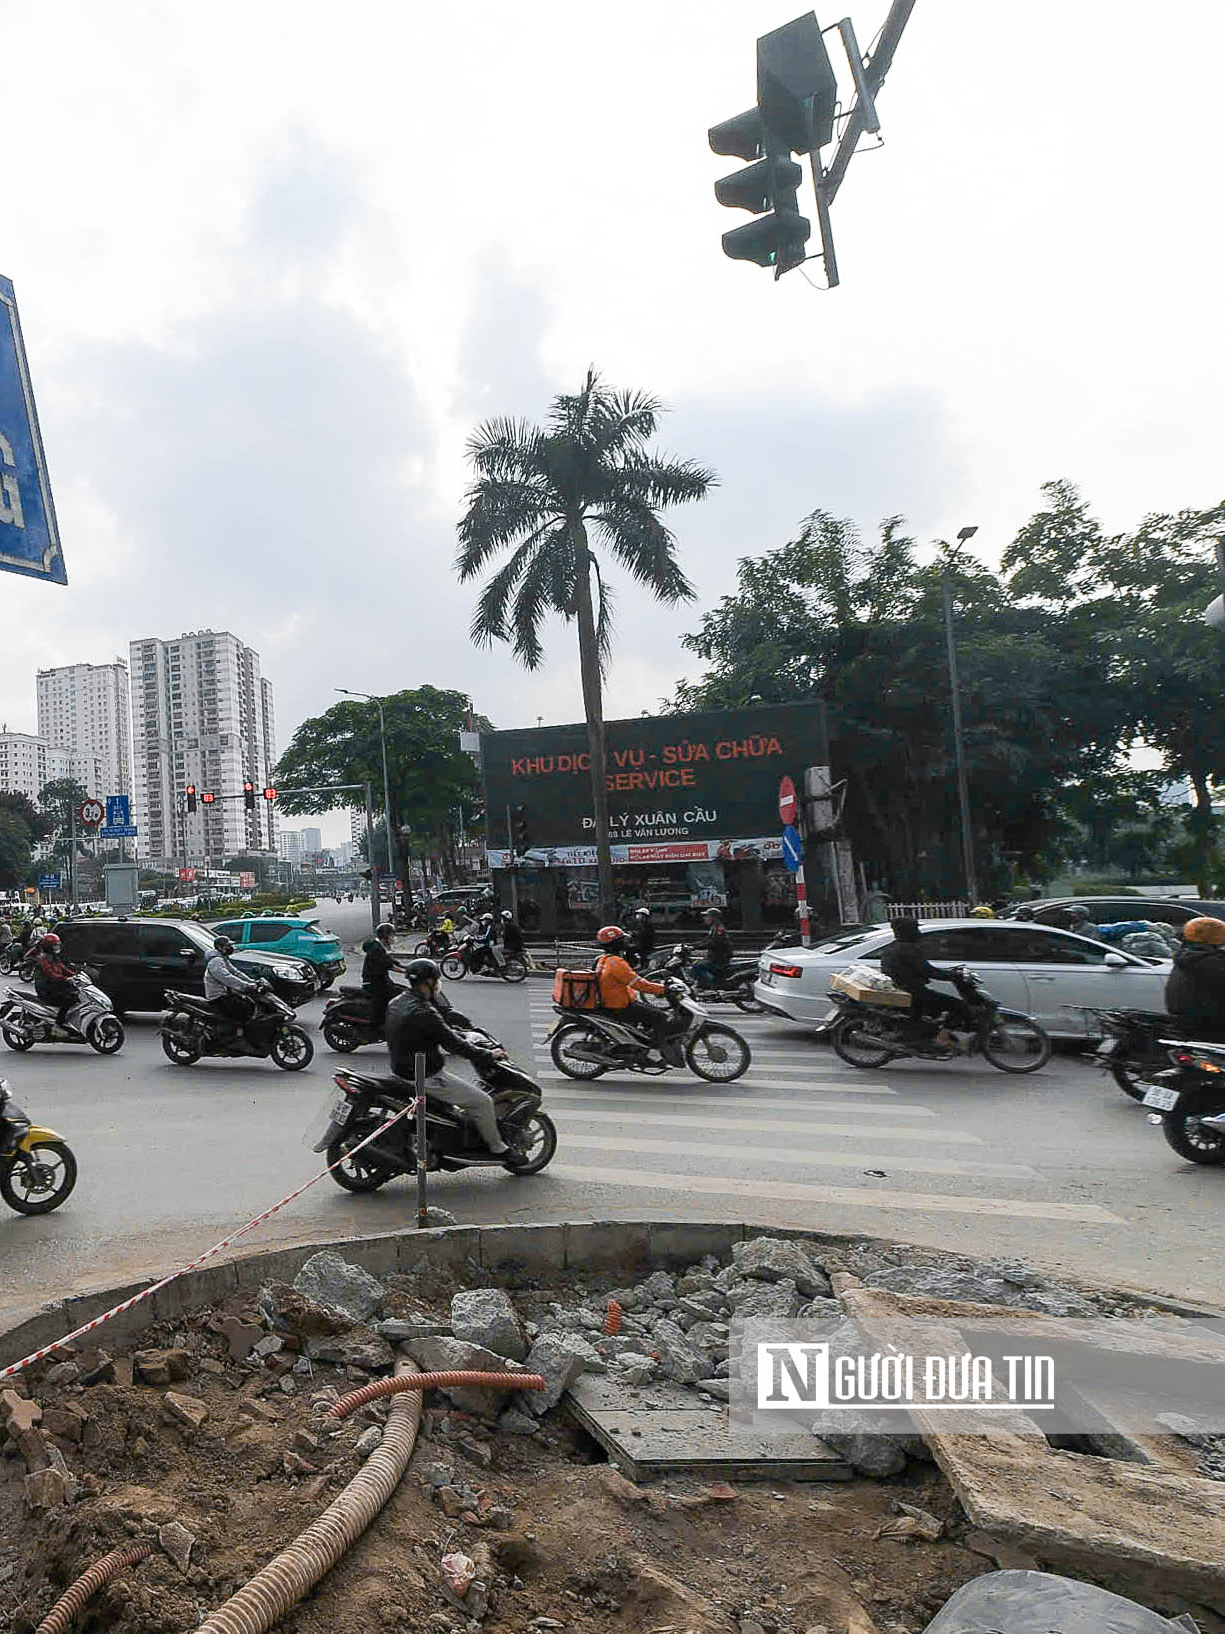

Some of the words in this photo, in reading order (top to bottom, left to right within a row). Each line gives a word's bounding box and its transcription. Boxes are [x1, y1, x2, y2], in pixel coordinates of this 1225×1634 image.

[511, 756, 554, 777] KHU
[558, 754, 606, 775] DỊC
[614, 749, 645, 770] VỤ
[662, 740, 710, 765] SỬA
[715, 735, 783, 760] CHỮA
[605, 768, 696, 791] SERVICE
[610, 812, 629, 829] LÝ
[635, 810, 677, 826] XUÂN
[683, 805, 718, 824] CẦU
